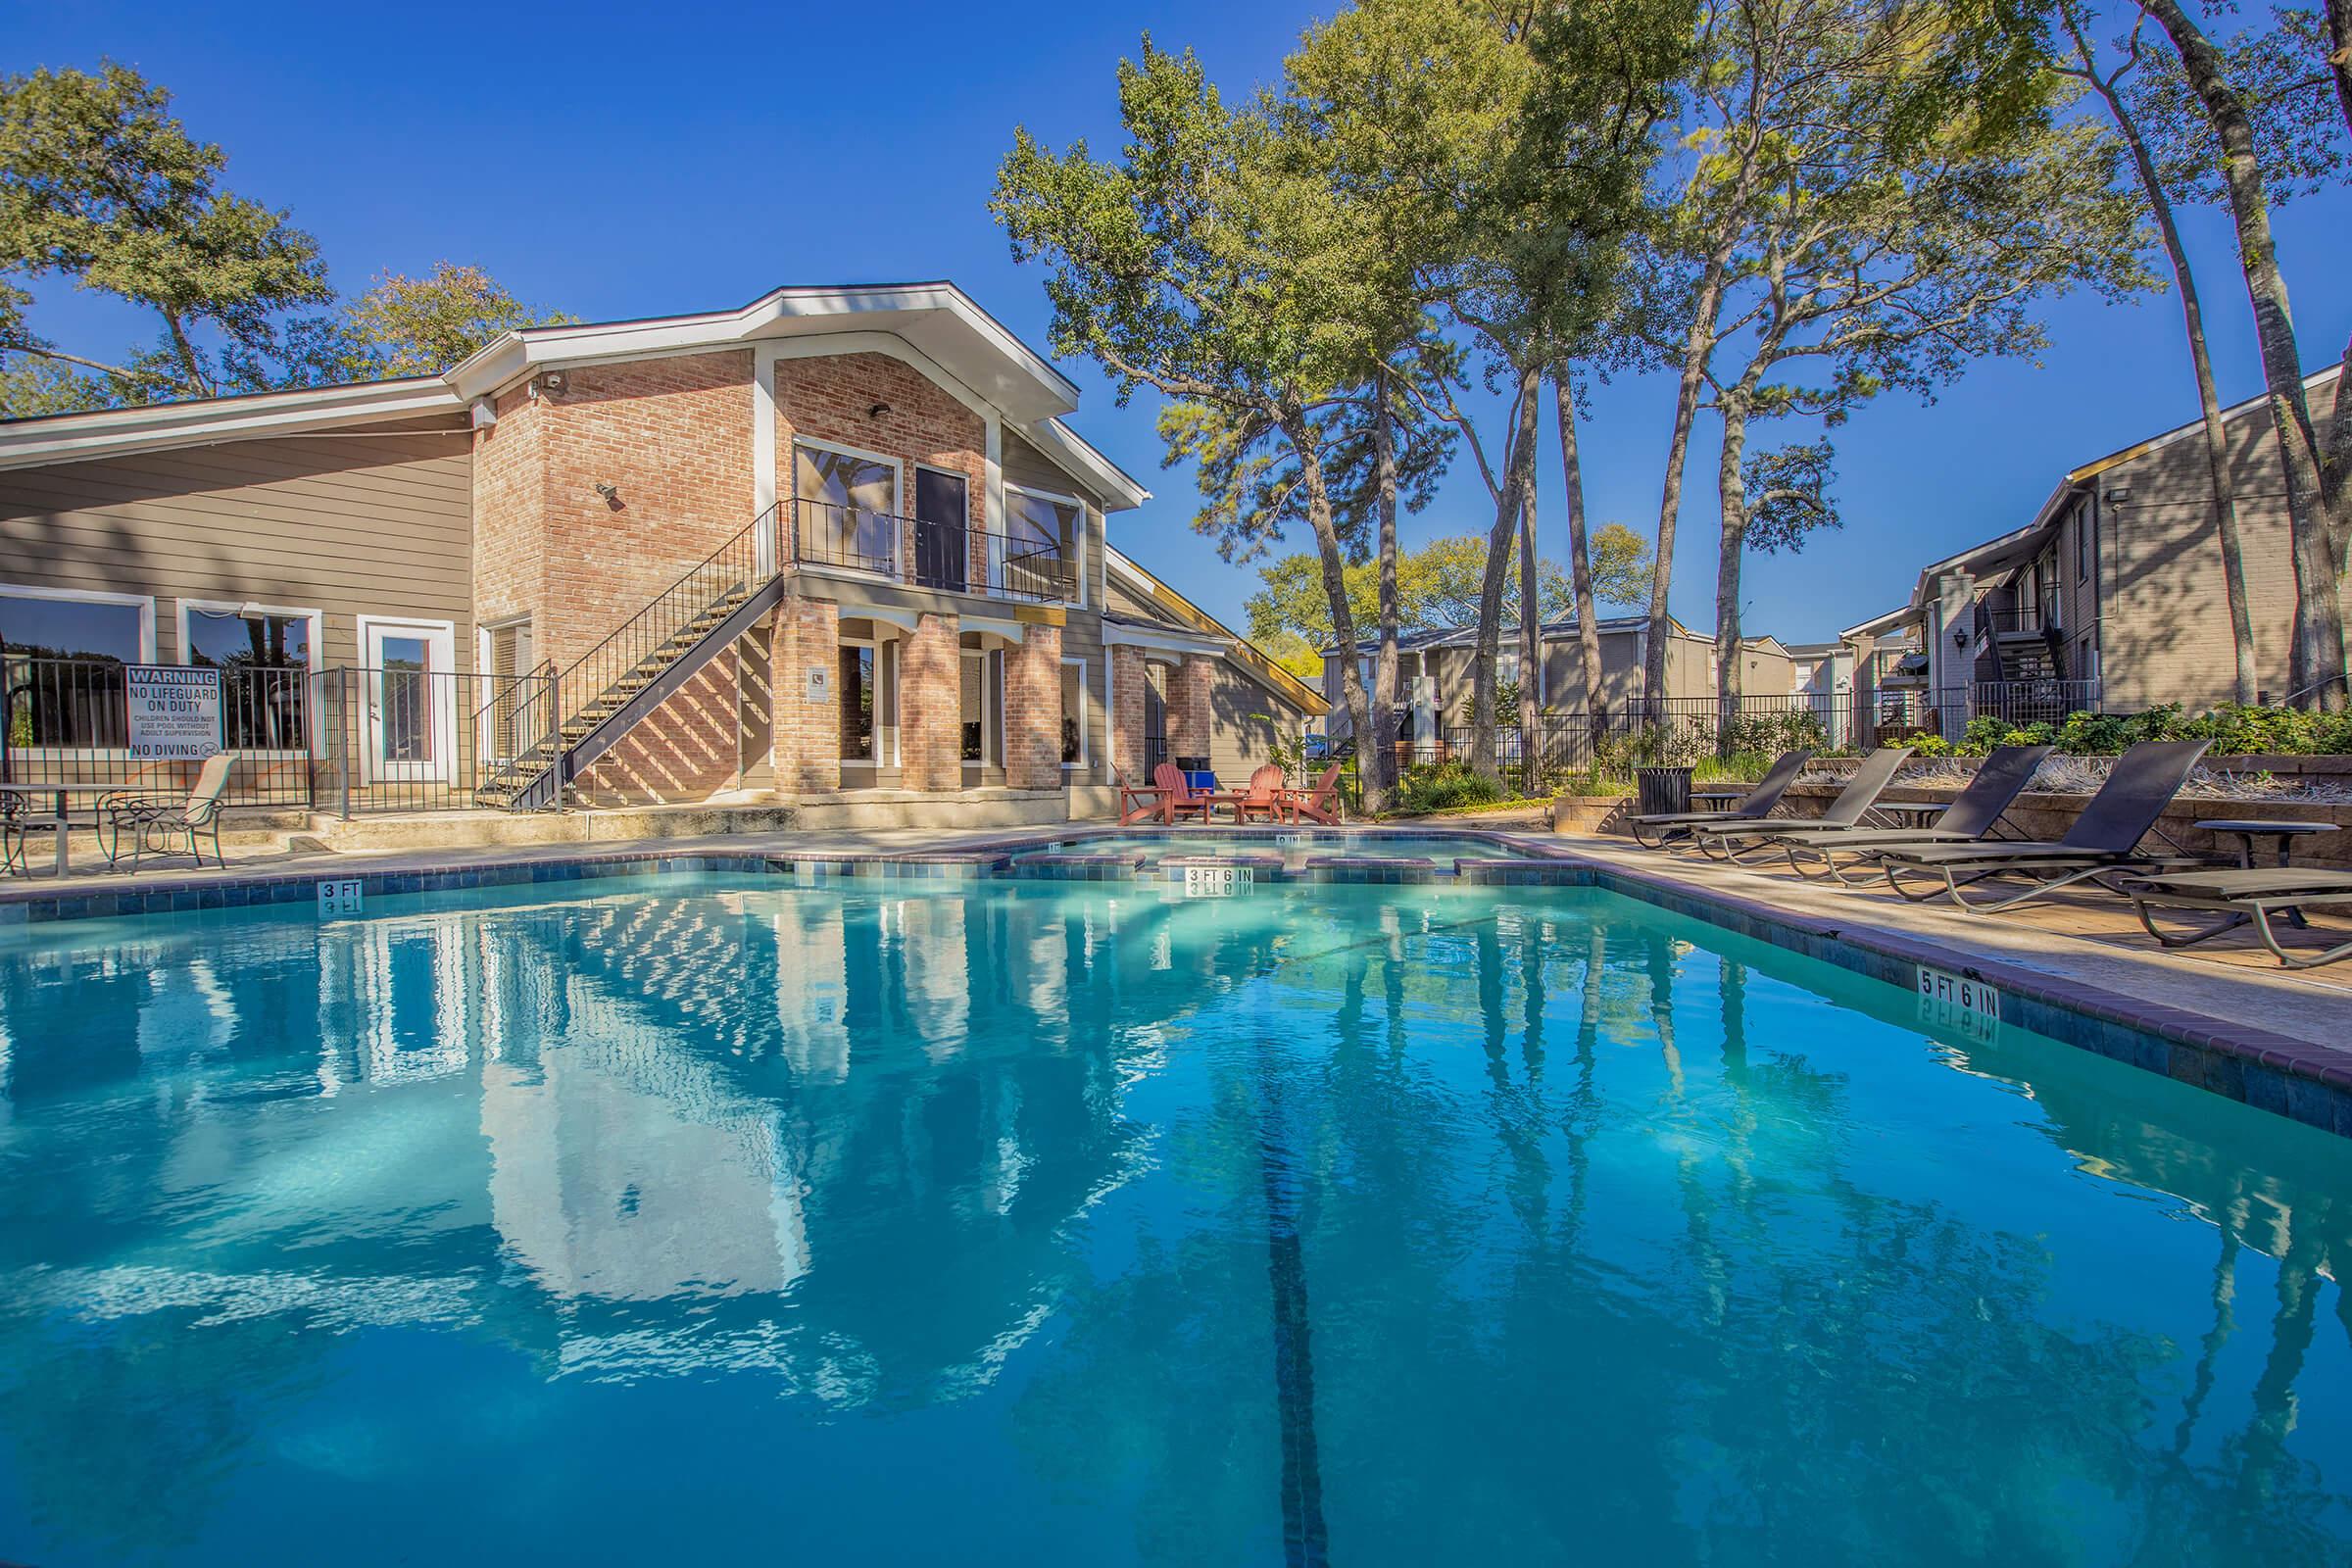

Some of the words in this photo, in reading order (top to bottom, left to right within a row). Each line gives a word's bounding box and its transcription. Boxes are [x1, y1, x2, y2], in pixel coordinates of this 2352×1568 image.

[130, 669, 216, 684] WARNING
[129, 687, 147, 698] NO
[152, 688, 218, 700] LIFEGUARD
[148, 700, 166, 711] ON
[170, 701, 201, 712] DUTY
[132, 745, 150, 755] NO
[156, 745, 198, 756] DIVING
[1190, 869, 1199, 881] 3
[1203, 869, 1218, 881] FT
[1224, 869, 1232, 881] 6
[1238, 869, 1250, 881] IN
[324, 884, 334, 897] 3
[342, 882, 360, 897] FT
[1922, 970, 1932, 994] 5
[1937, 975, 1954, 1002] FT
[1961, 983, 1972, 1007] 6
[1979, 988, 1996, 1016] IN
